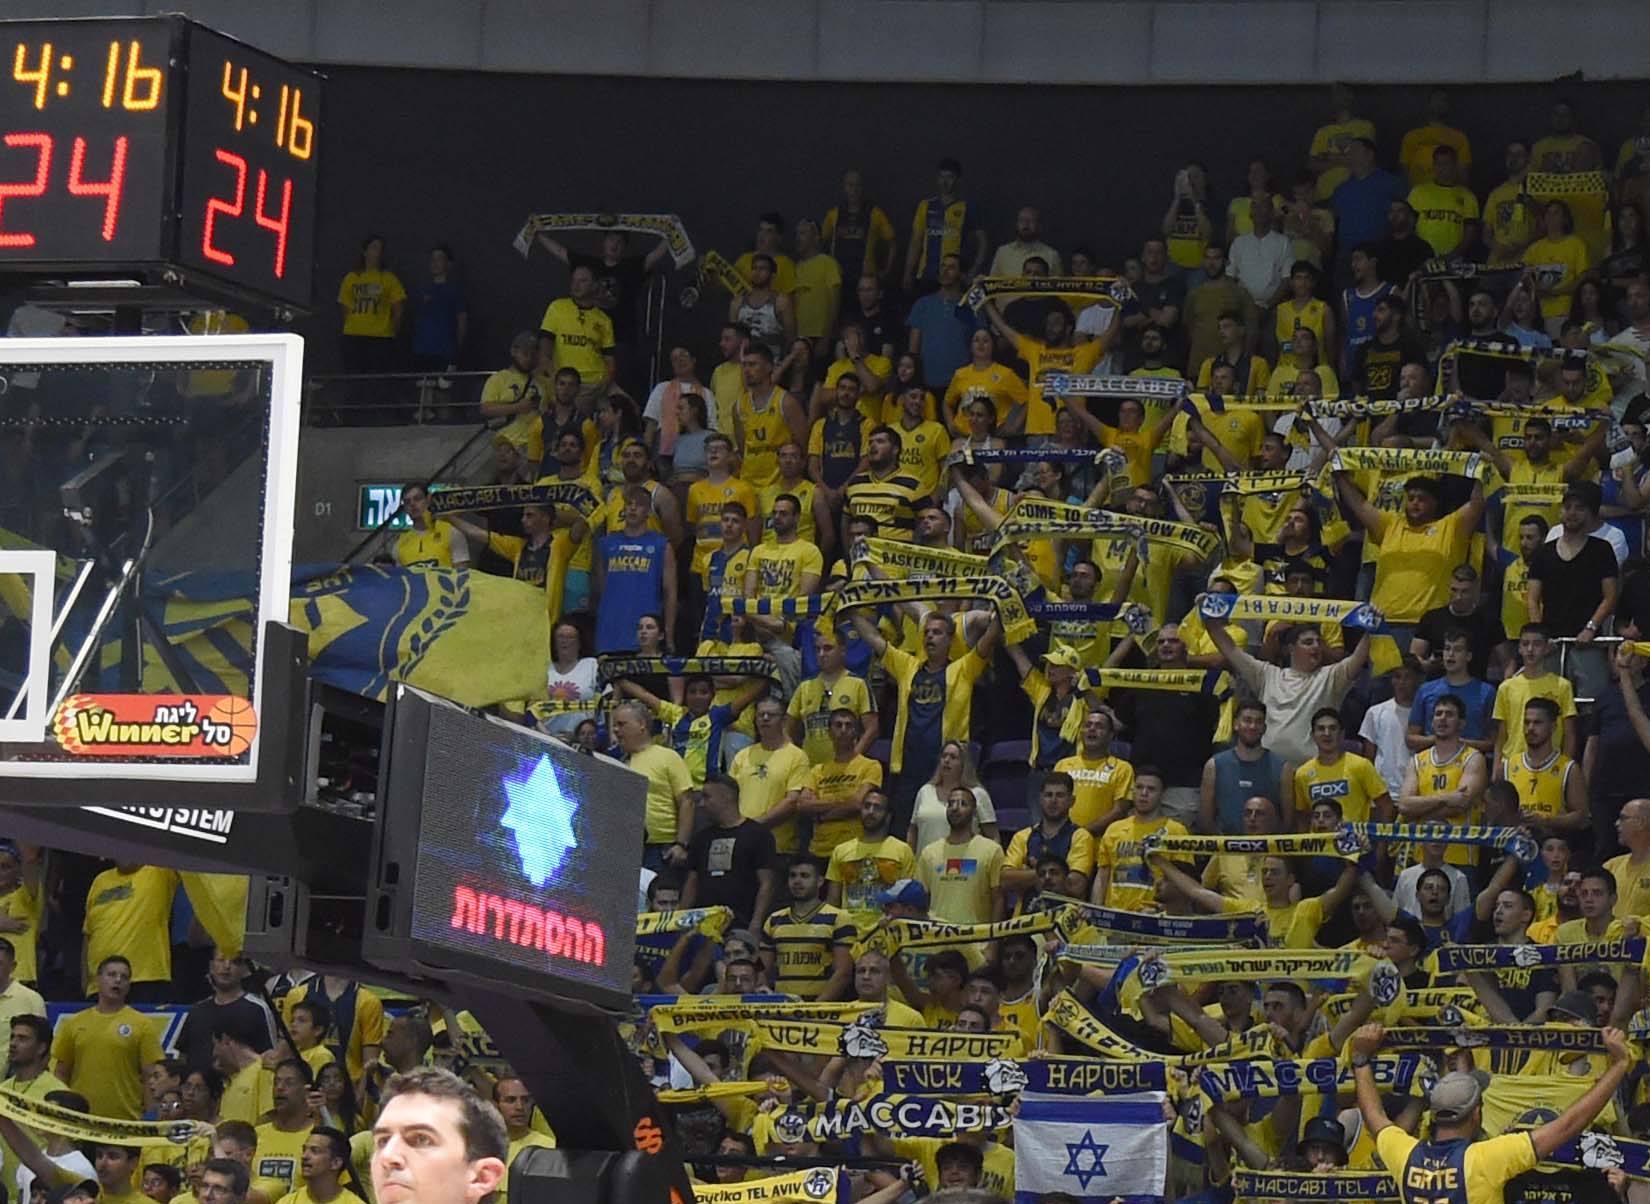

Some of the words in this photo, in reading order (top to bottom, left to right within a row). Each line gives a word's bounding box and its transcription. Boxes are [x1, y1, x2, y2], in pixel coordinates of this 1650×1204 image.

[13, 40, 163, 110] 4:16
[221, 59, 316, 160] 4:16
[0, 133, 128, 242] 24
[201, 149, 294, 279] 24
[1554, 417, 1587, 428] FOX
[1016, 504, 1058, 522] COME
[1063, 508, 1080, 522] TO
[1180, 529, 1212, 550] HELL
[906, 578, 931, 596] יד
[938, 577, 957, 594] 11
[155, 701, 198, 726] ליגת
[74, 710, 200, 745] Winner
[201, 718, 232, 746] סל
[1310, 781, 1349, 798] FOX
[1226, 839, 1267, 852] FOX
[1275, 838, 1298, 852] TEL
[1300, 838, 1326, 853] AVIV
[450, 886, 605, 966] ההסתדרות
[1449, 947, 1497, 964] FVCK
[1555, 940, 1632, 960] HAPOEL
[1226, 960, 1272, 975] ישראל
[1274, 960, 1335, 976] אפריקה
[769, 1026, 818, 1048] VCK
[1506, 1030, 1605, 1048] HAPOEL
[896, 1063, 963, 1089] FVCK
[1046, 1062, 1153, 1089] HAPOEL
[1253, 1181, 1329, 1197] MACCABI
[1334, 1181, 1367, 1197] TEL
[1375, 1181, 1399, 1197] AV
[1406, 1167, 1458, 1190] GATE
[746, 1186, 770, 1201] TEL
[772, 1181, 802, 1198] AVIV
